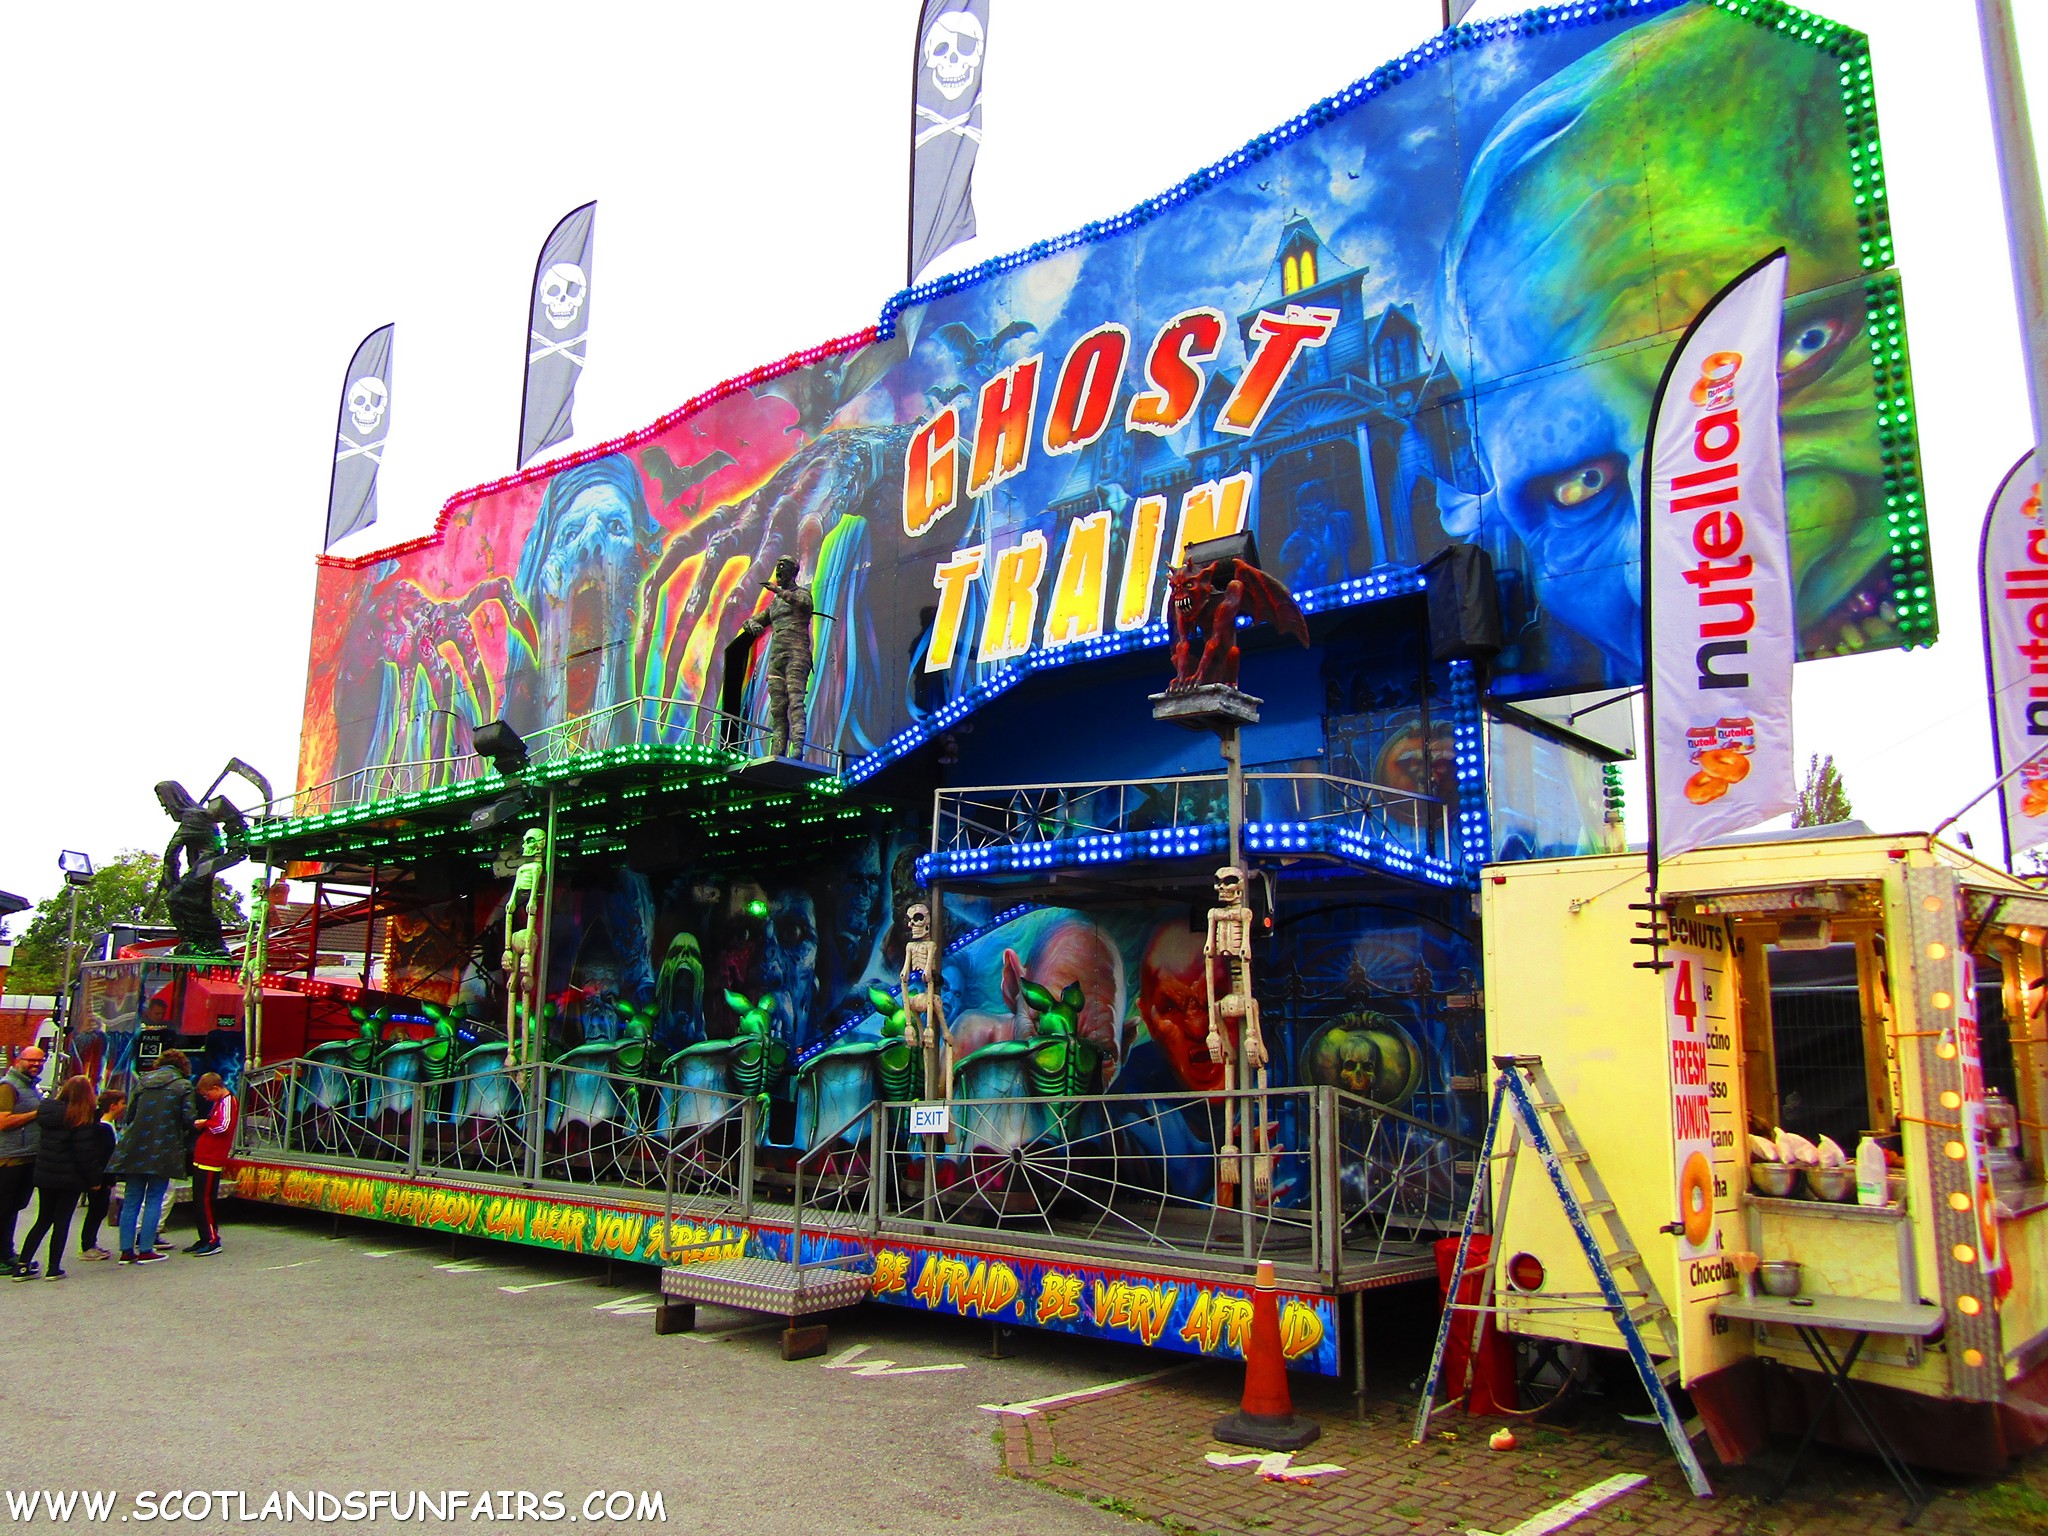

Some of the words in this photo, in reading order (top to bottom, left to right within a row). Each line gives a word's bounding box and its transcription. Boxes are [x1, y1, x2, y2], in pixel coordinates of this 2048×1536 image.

[903, 304, 1341, 538] GHOST
[1670, 409, 1755, 690] nutella
[1718, 727, 1754, 739] nutella
[1669, 917, 1723, 952] DONUTS
[1673, 960, 1697, 1032] 4
[1705, 1026, 1730, 1050] ccino
[1672, 1040, 1708, 1085] FRESH
[1709, 1081, 1727, 1098] sso
[916, 1111, 943, 1126] EXIT
[1676, 1094, 1710, 1140] DONUTS
[1710, 1129, 1733, 1147] cano
[1713, 1174, 1727, 1197] ha
[237, 1167, 256, 1195] ON
[257, 1168, 282, 1199] THE
[282, 1169, 329, 1205] GHOST
[384, 1185, 483, 1230] EVERYBODY
[486, 1197, 527, 1240] CAN
[531, 1202, 586, 1253] HEAR
[592, 1209, 643, 1254] YOU
[872, 1249, 910, 1296] BE
[913, 1253, 1024, 1317] AFRAID,
[1036, 1270, 1083, 1323] BE
[1095, 1279, 1178, 1346] VERY
[1180, 1290, 1323, 1360] AFRID
